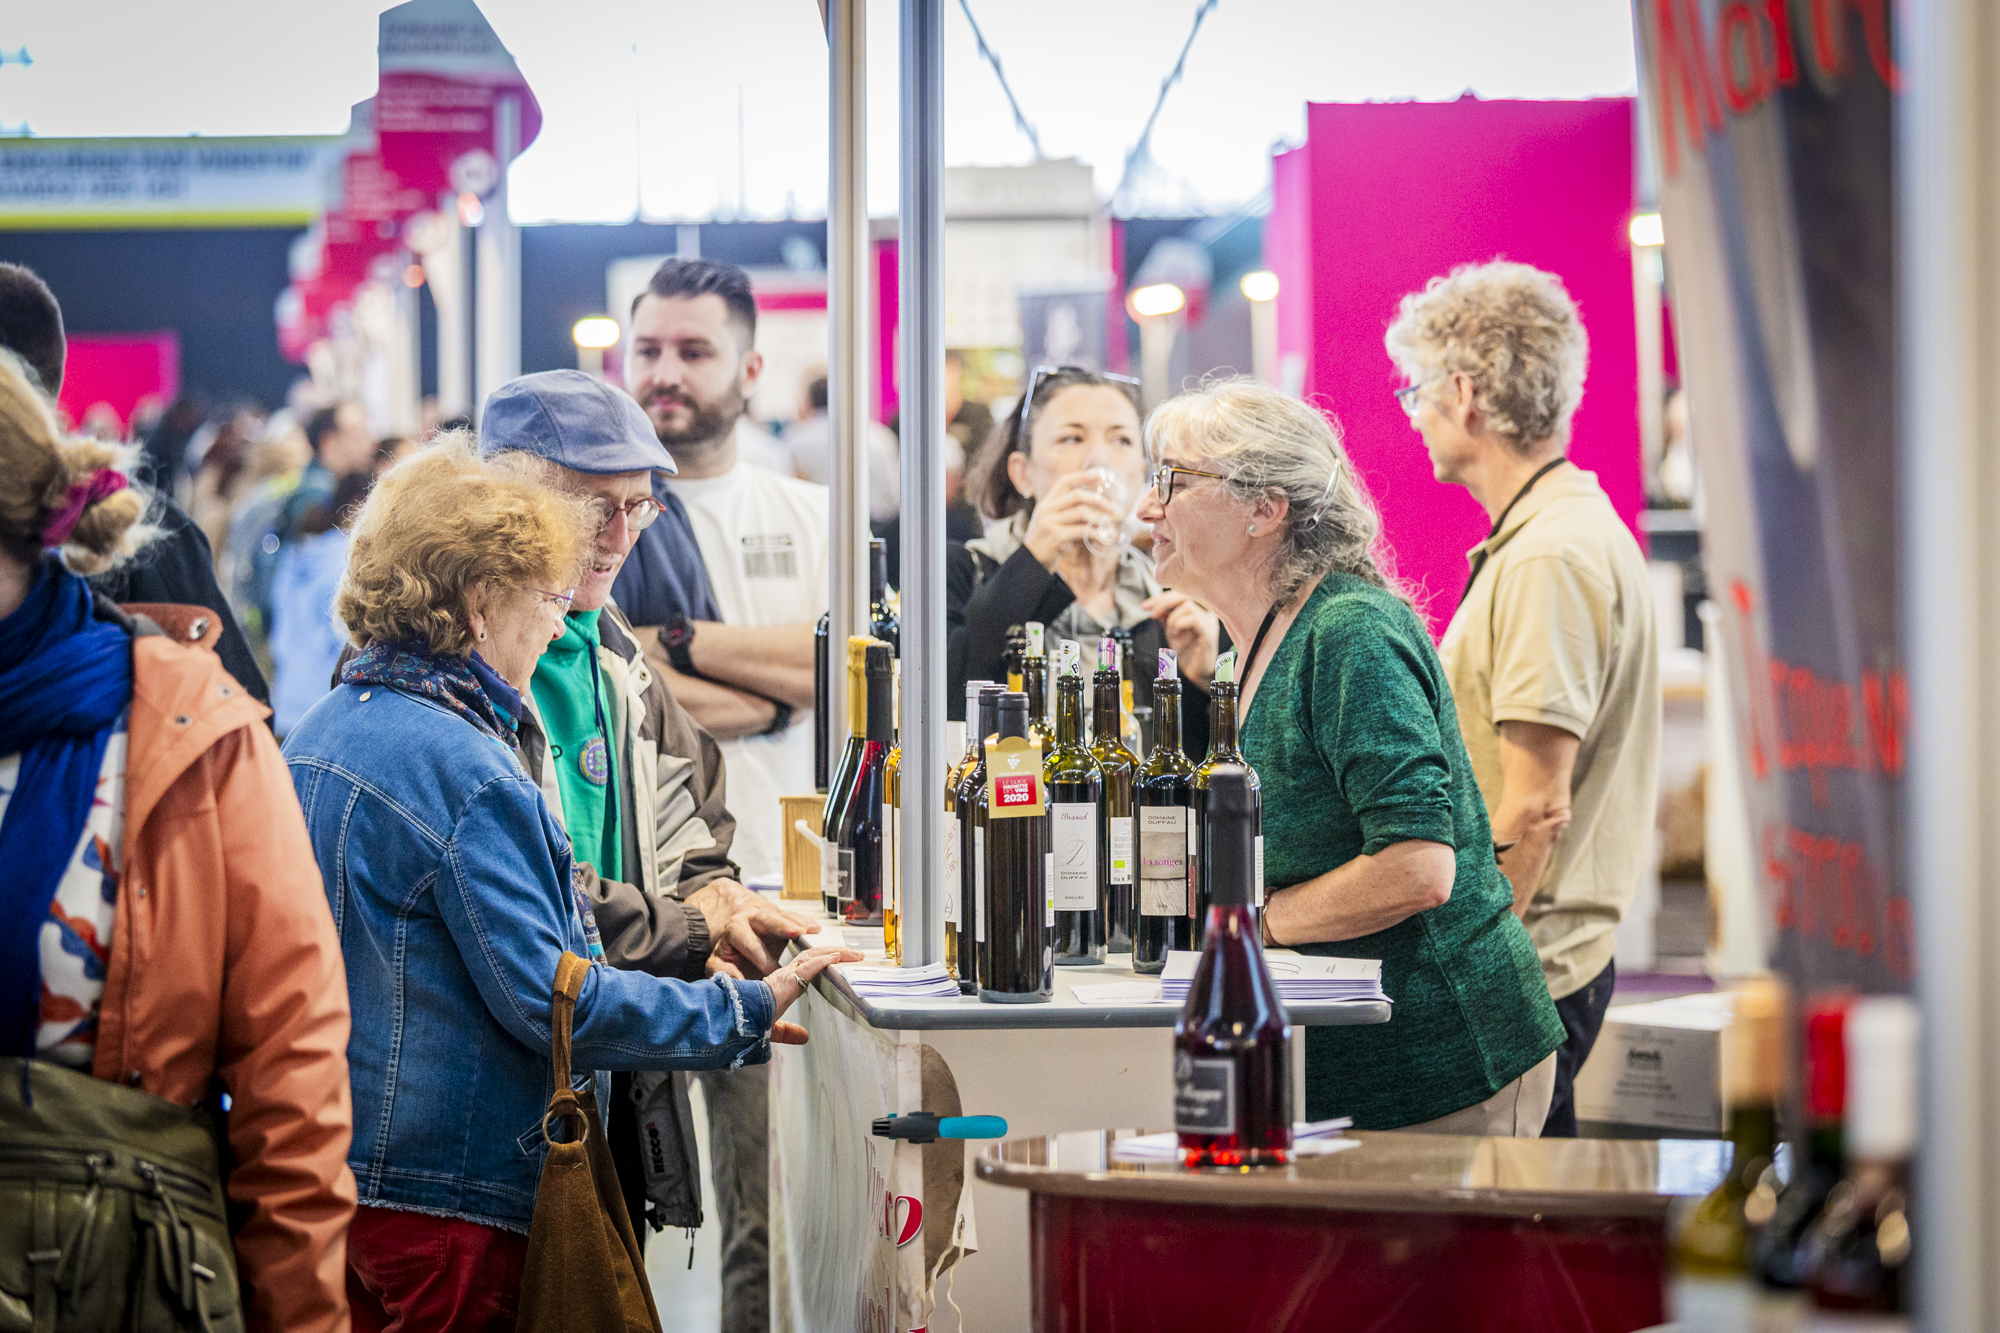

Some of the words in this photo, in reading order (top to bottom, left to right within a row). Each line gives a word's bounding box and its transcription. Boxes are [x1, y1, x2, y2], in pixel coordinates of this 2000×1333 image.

[1003, 793, 1029, 803] 2020
[1143, 857, 1153, 866] les
[1154, 858, 1183, 868] songes
[648, 1127, 665, 1173] RECCO
